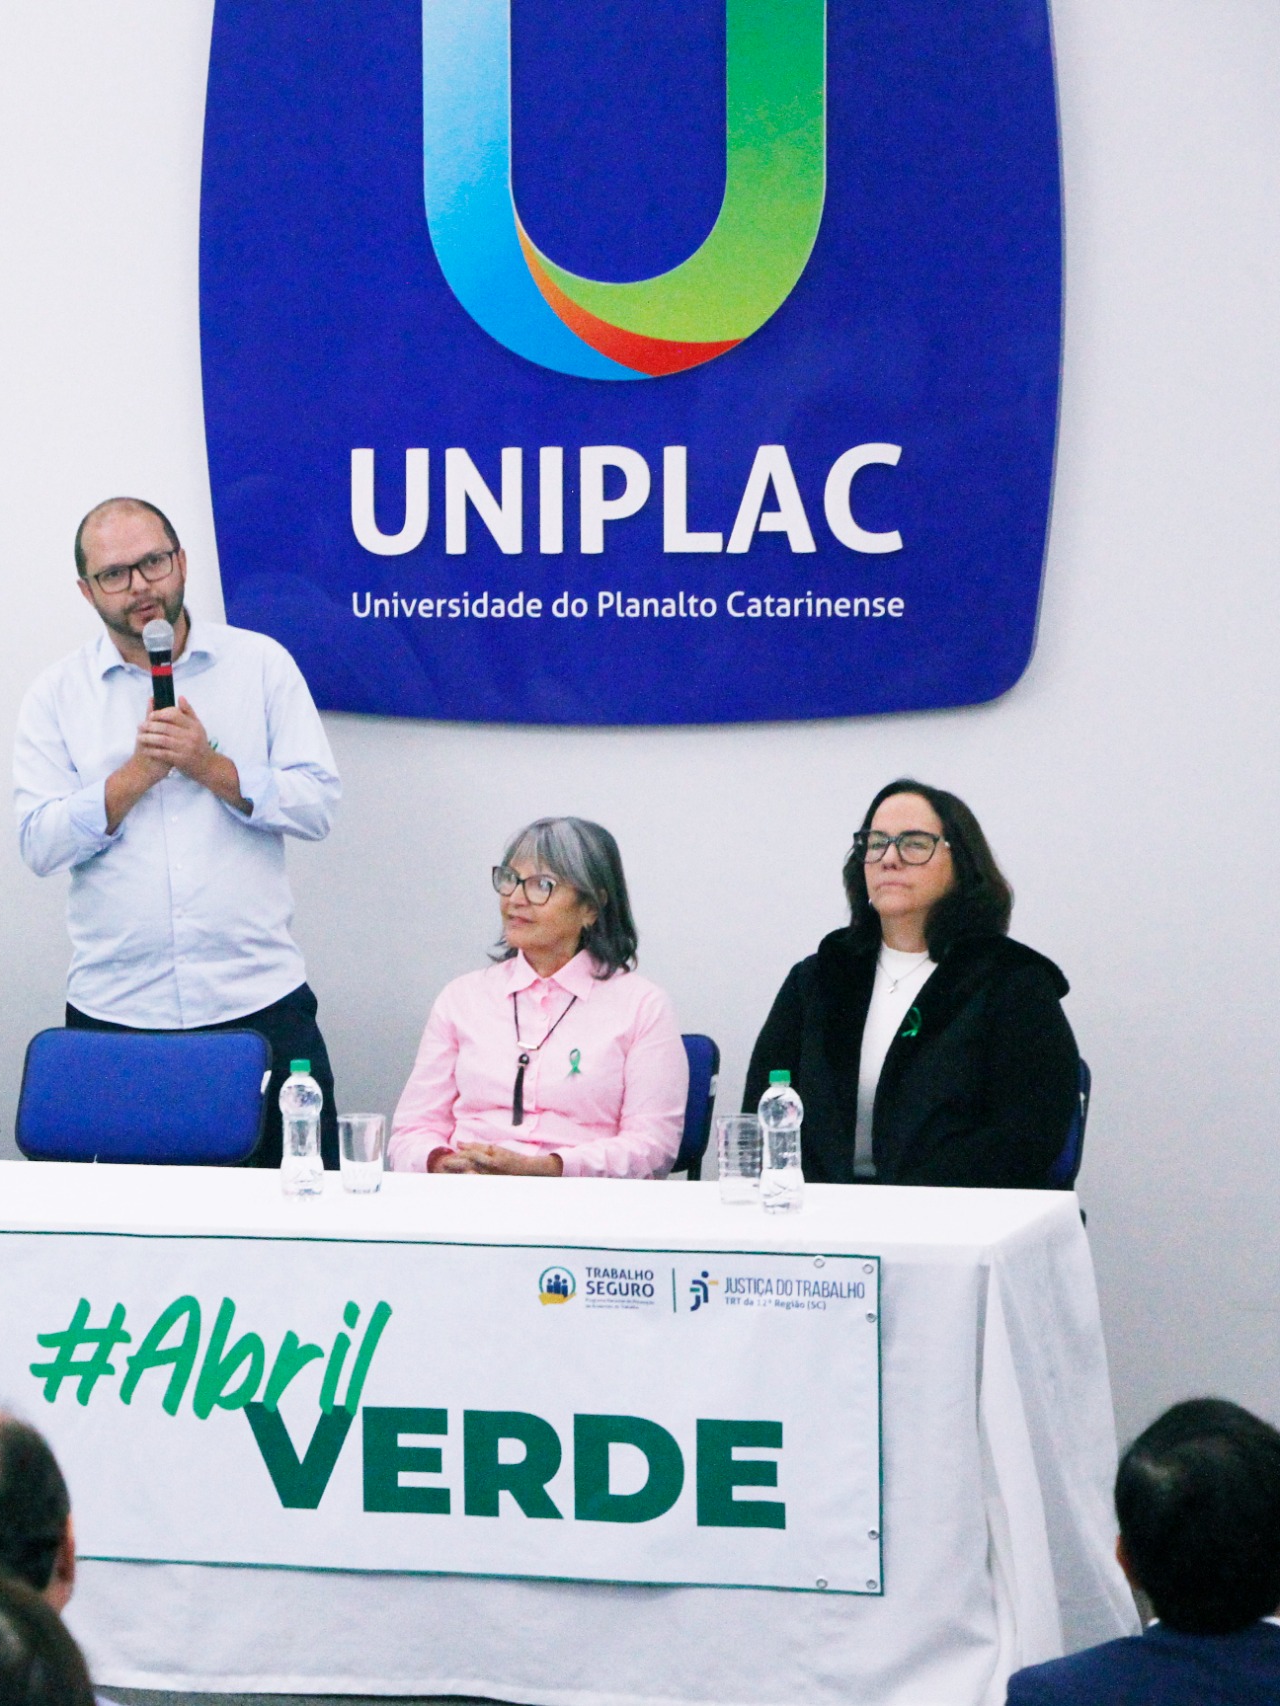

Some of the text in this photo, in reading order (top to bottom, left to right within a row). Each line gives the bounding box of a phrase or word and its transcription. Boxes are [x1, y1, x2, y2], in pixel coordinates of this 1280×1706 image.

[350, 443, 903, 556] UNIPLAC
[352, 591, 905, 618] Universidade do Planalto Catarinense
[585, 1266, 654, 1281] TRABALHO
[586, 1280, 655, 1298] SEGURO
[724, 1277, 866, 1299] JUSTIÇA DO TRABALHO
[725, 1297, 741, 1305] TRT
[774, 1299, 805, 1310] Região
[807, 1300, 827, 1310] (SC)
[29, 1295, 393, 1419] #Abril
[244, 1400, 787, 1531] VERDE
